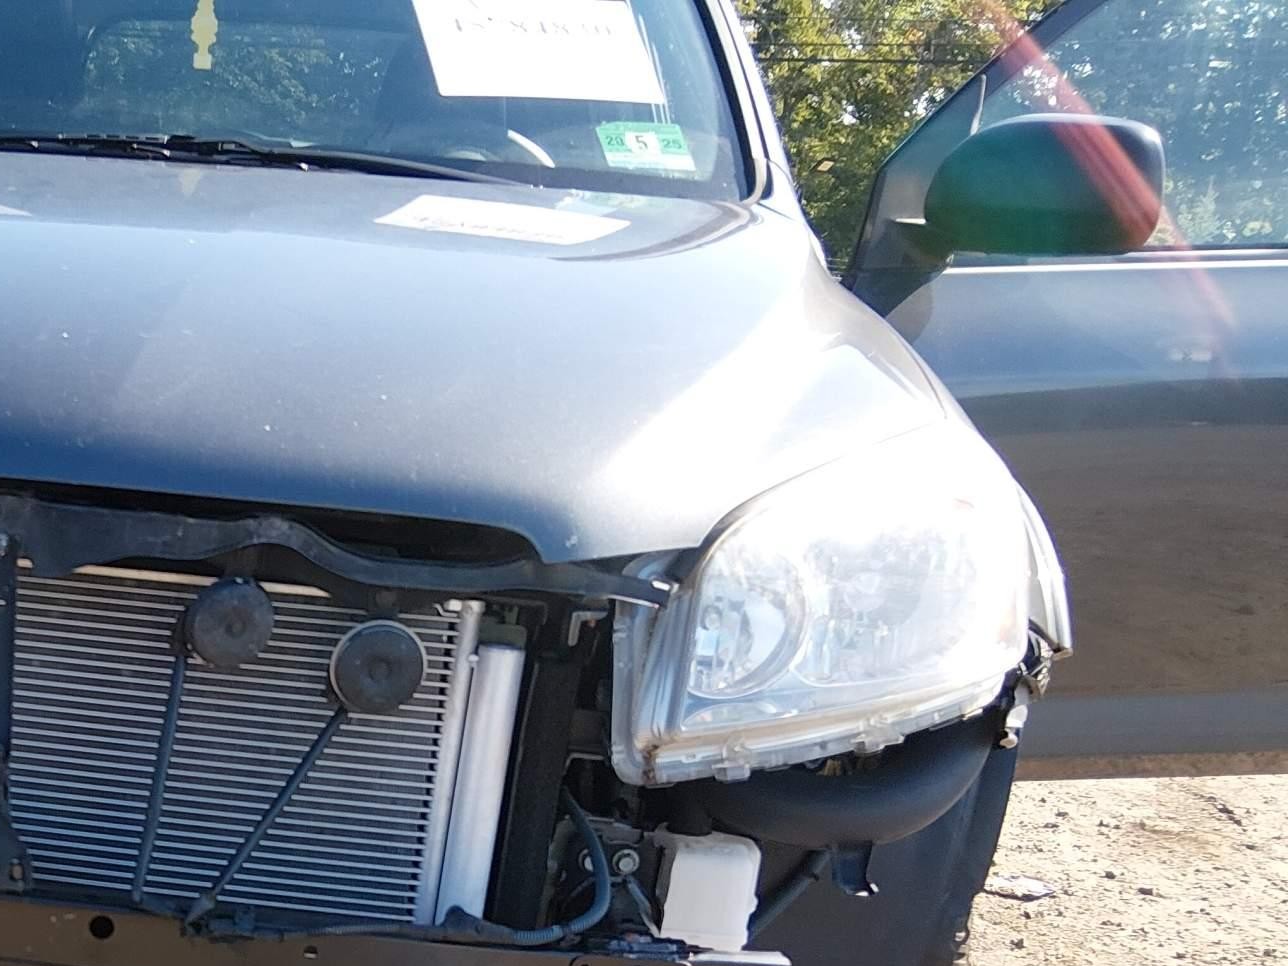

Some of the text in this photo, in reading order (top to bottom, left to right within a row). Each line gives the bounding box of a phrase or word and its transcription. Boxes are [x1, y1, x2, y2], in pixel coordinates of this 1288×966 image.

[605, 135, 683, 151] 20 5 25
